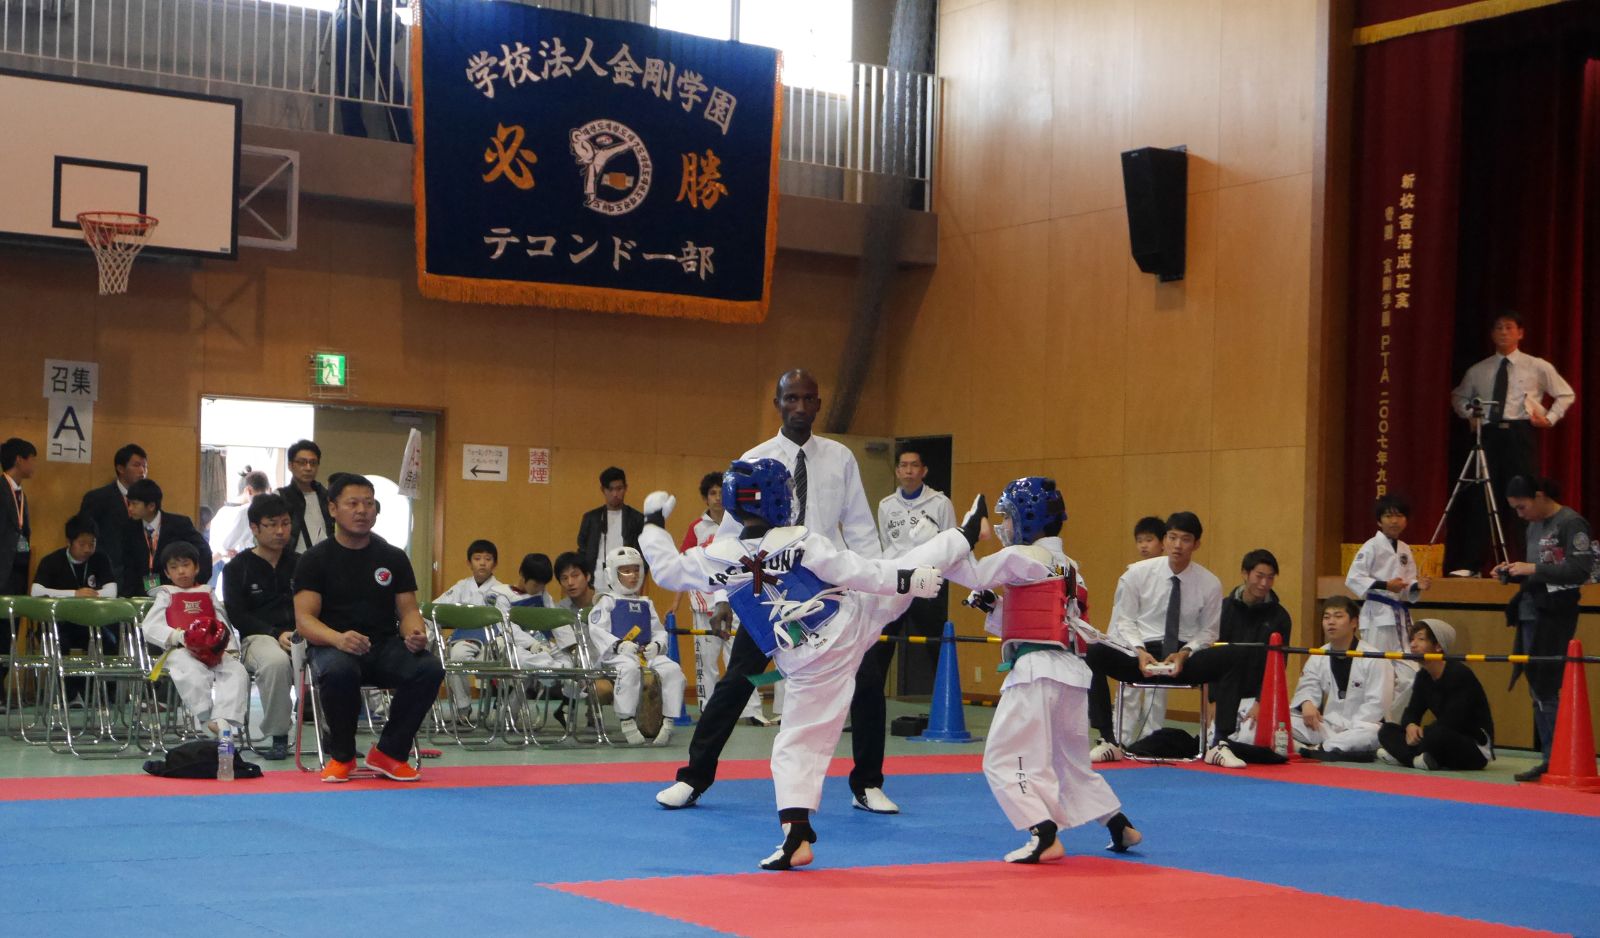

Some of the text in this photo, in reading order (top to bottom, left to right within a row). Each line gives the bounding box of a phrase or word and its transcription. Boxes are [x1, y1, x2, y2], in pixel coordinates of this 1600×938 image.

[465, 37, 737, 136] 学校法人金剛学園
[481, 121, 538, 190] 必
[676, 148, 728, 210] 勝
[484, 227, 715, 281] テコンドー部
[51, 366, 91, 395] 召集
[53, 405, 86, 441] A
[51, 442, 87, 459] コート
[529, 450, 549, 482] 禁煙
[1016, 756, 1027, 794] ITF
